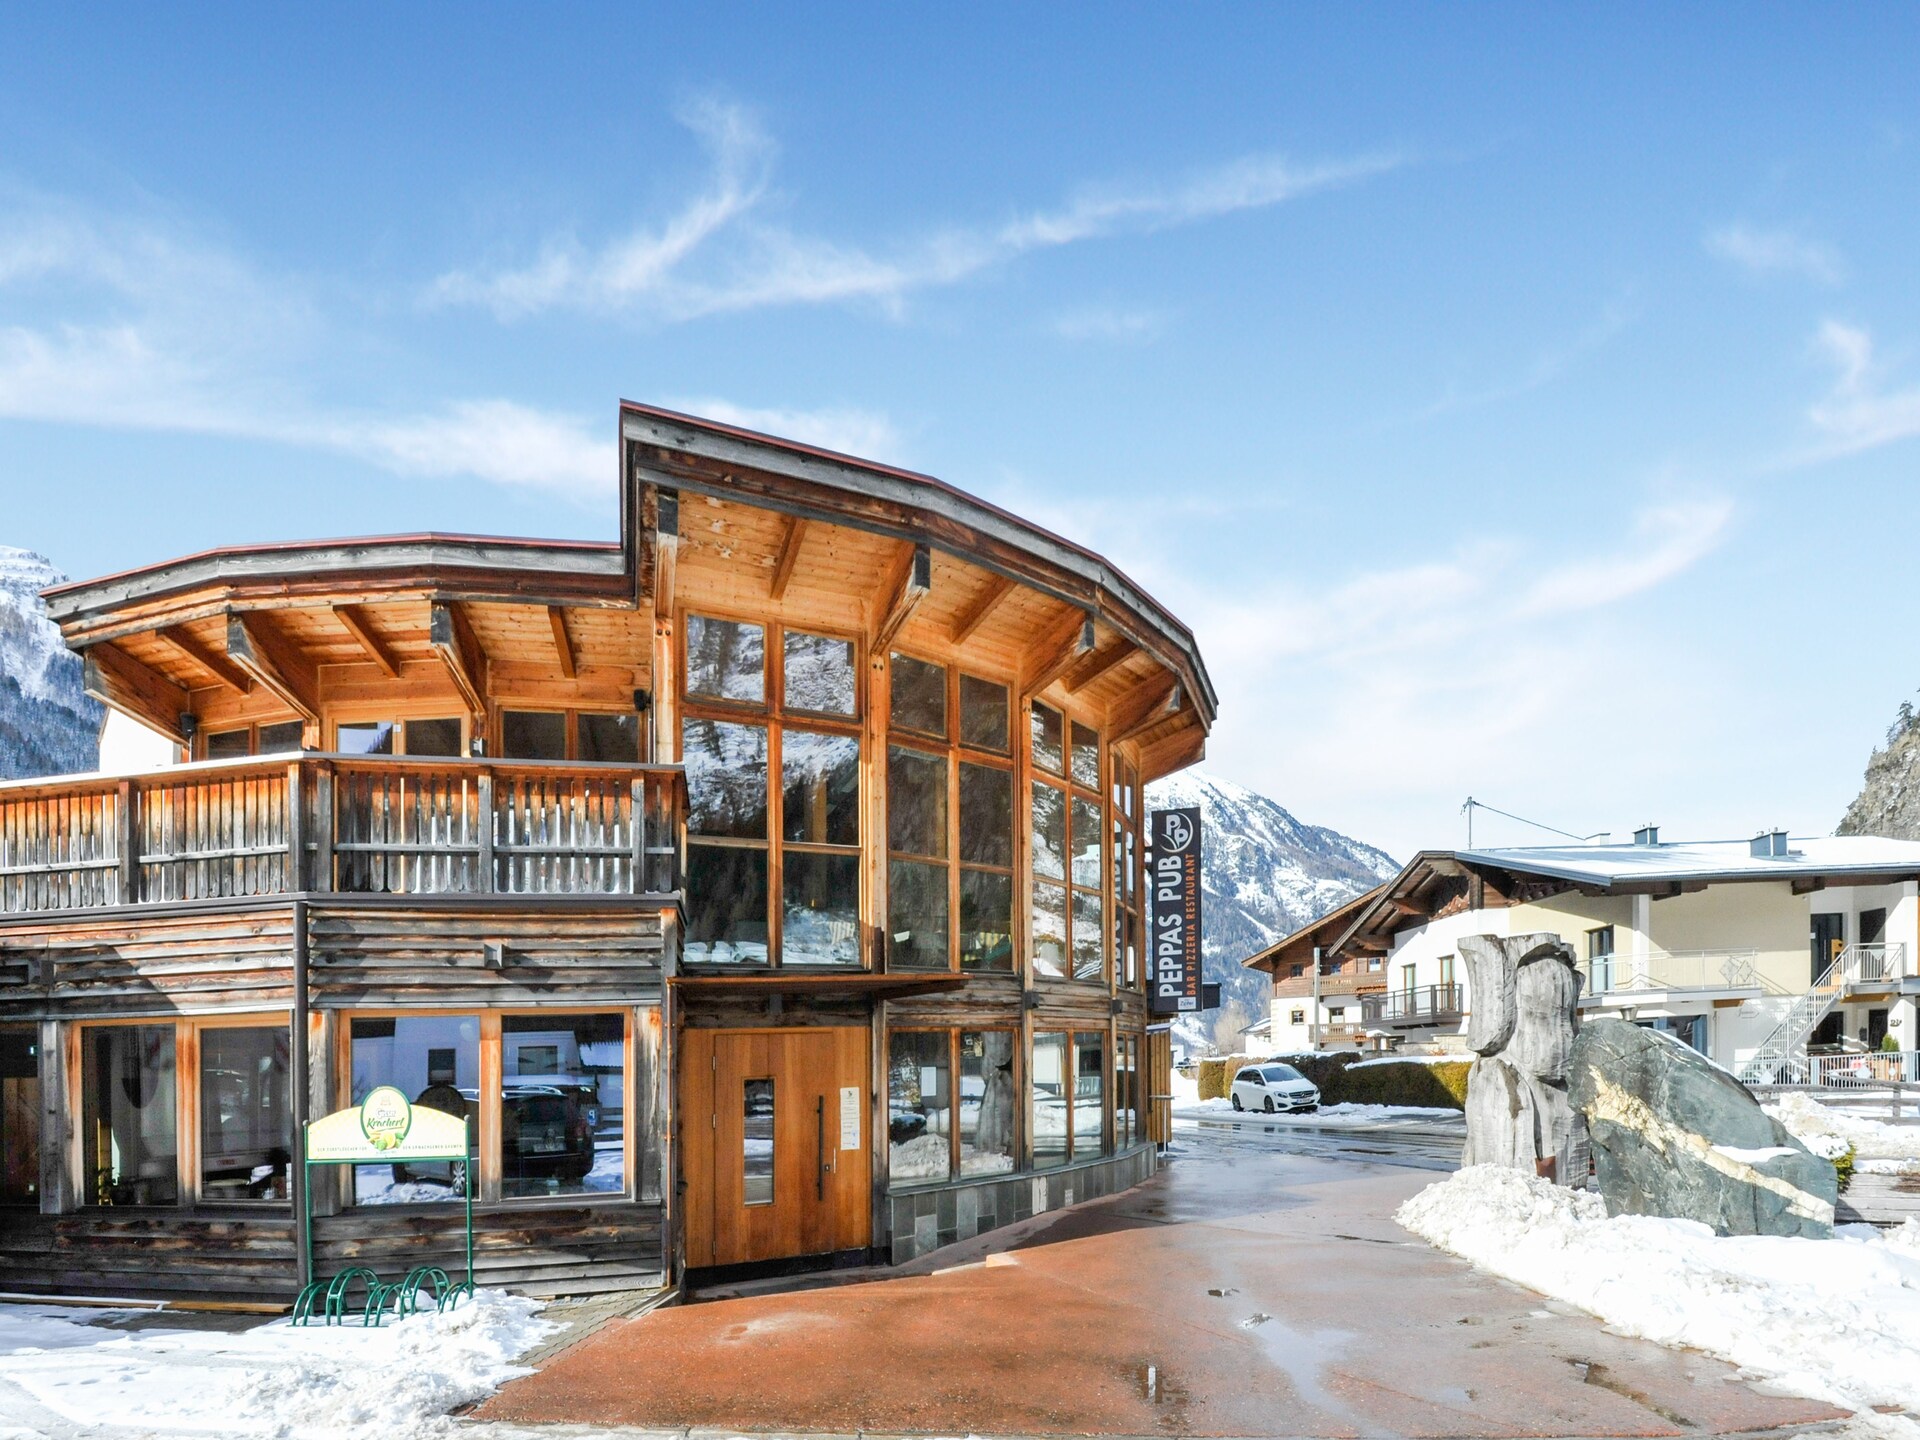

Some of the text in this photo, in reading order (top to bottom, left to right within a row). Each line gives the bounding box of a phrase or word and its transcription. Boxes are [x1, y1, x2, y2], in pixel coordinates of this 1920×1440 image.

[1158, 855, 1183, 997] PEPPAS PUB
[1185, 853, 1196, 996] BAR PIZZERIA RESTAURANT
